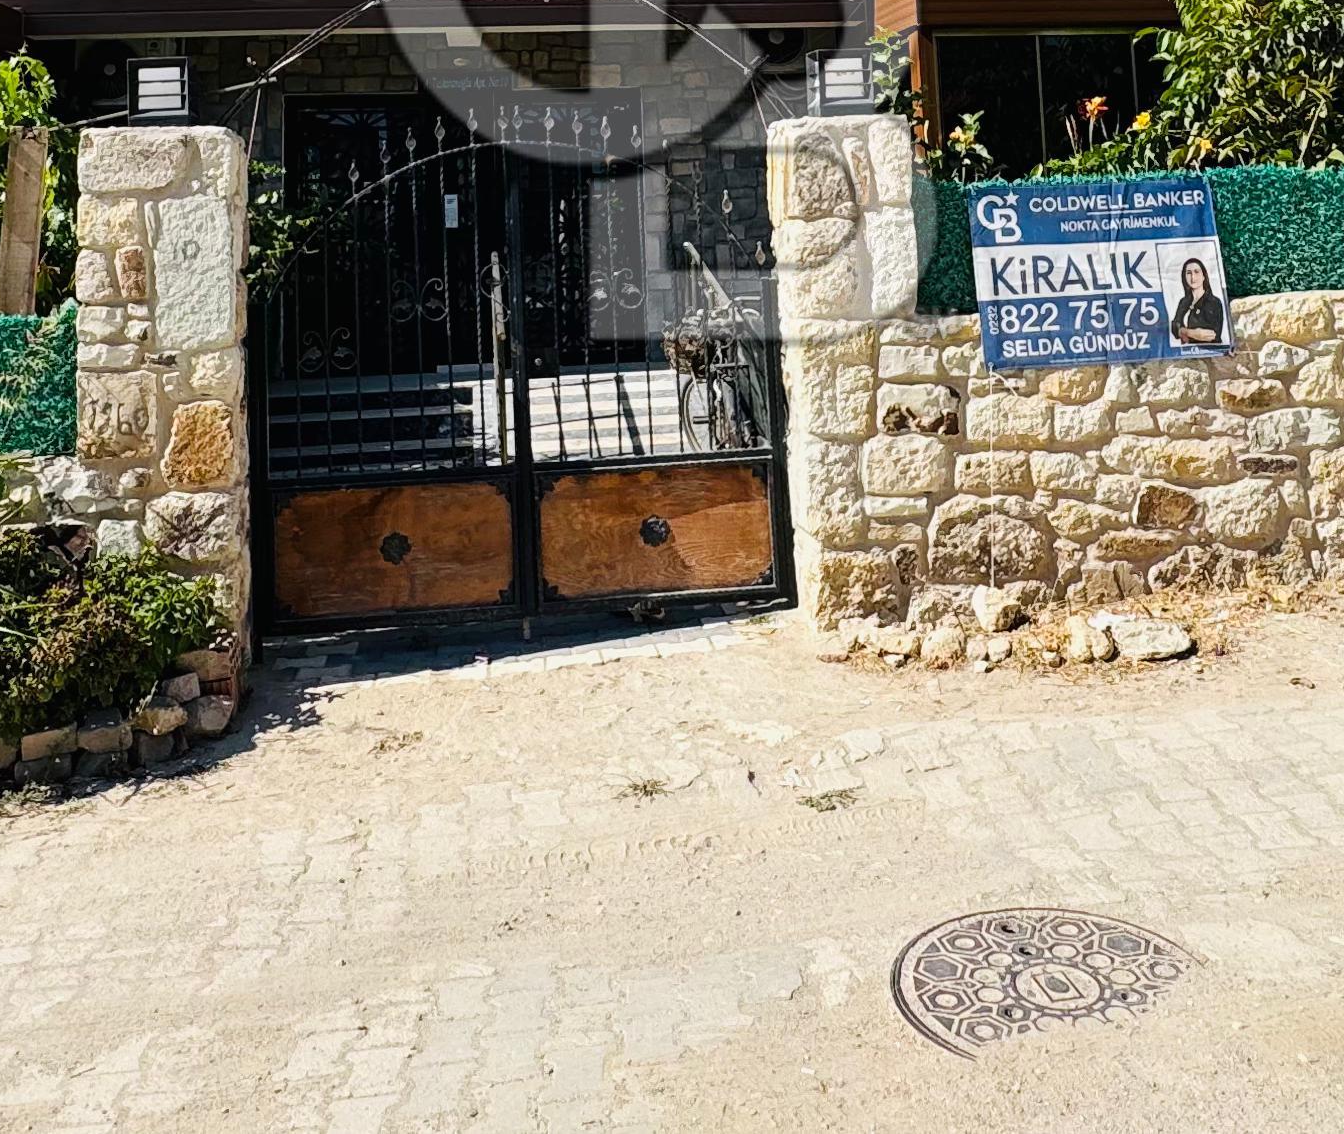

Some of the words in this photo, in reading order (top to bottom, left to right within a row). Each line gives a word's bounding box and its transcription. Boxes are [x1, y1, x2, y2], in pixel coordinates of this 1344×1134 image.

[1029, 194, 1129, 213] COLDWELL
[1134, 190, 1205, 208] BANKER
[1060, 219, 1099, 233] NOKTA
[988, 305, 1000, 336] 0232
[1000, 302, 1061, 335] 822
[1068, 300, 1109, 330] 75
[1118, 297, 1159, 327] 75
[1002, 338, 1066, 359] SELDA
[1069, 330, 1151, 354] GÜNDÜZ
